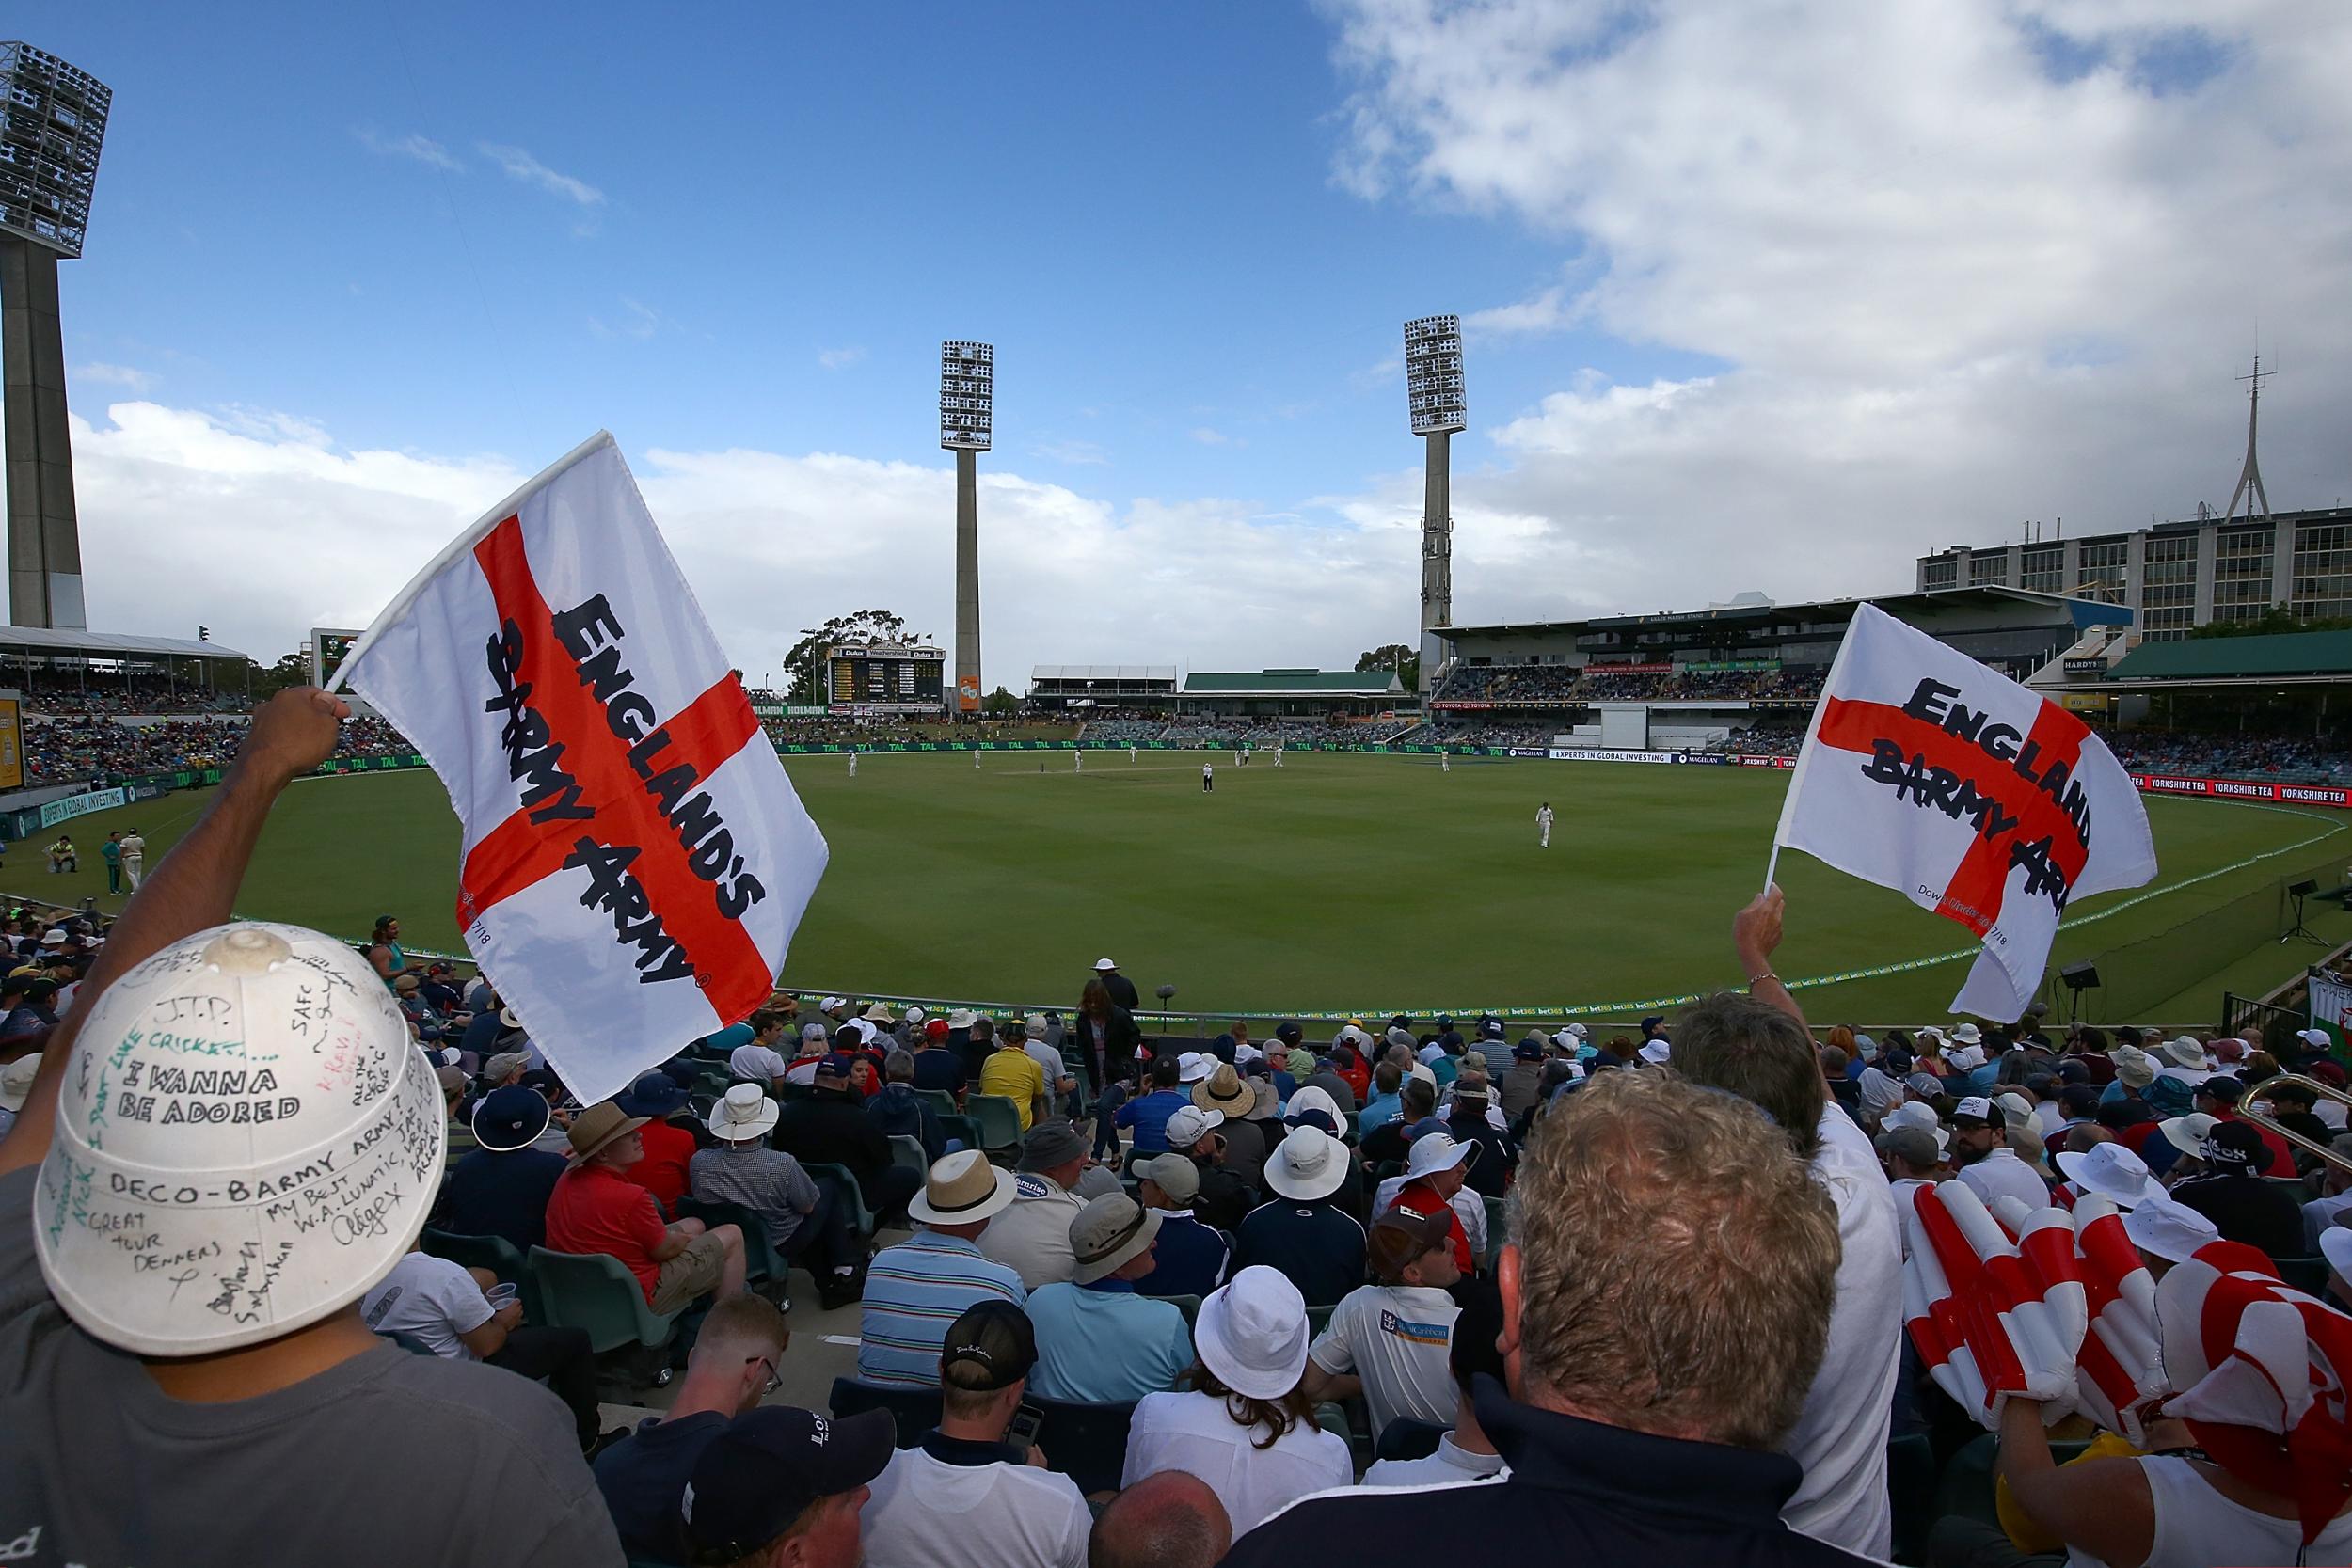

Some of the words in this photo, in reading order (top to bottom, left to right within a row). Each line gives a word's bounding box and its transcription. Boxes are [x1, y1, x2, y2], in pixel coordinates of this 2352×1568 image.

[551, 592, 768, 921] ENGLAND'S
[1626, 753, 1664, 762] INVESTING
[1861, 737, 2020, 844] BARMY
[2152, 779, 2191, 790] YORKSHIRE
[2192, 781, 2207, 791] TEA
[2215, 783, 2256, 796] YORKSHIRE
[2258, 786, 2273, 797] TEA
[68, 798, 87, 815] GLOBAL
[88, 790, 119, 809] INVESTING
[485, 615, 596, 826] BARMY
[562, 834, 696, 985] ARMY
[2282, 788, 2328, 801] YORKSHIRE
[2329, 792, 2346, 802] TEA
[1917, 884, 1949, 905] Down
[1511, 1006, 1536, 1015] bet365
[1538, 1006, 1564, 1015] bet365
[1565, 1006, 1588, 1015] bet365
[1613, 1003, 1635, 1011] bet365
[1635, 1001, 1657, 1009] bet365
[122, 1059, 145, 1087] I
[149, 1064, 278, 1096] WANNA
[117, 1091, 156, 1123] BE
[160, 1097, 300, 1125] ADORED
[111, 1151, 335, 1204] DECO-BARMY
[267, 1198, 301, 1223] MY
[303, 1173, 349, 1208] BEST
